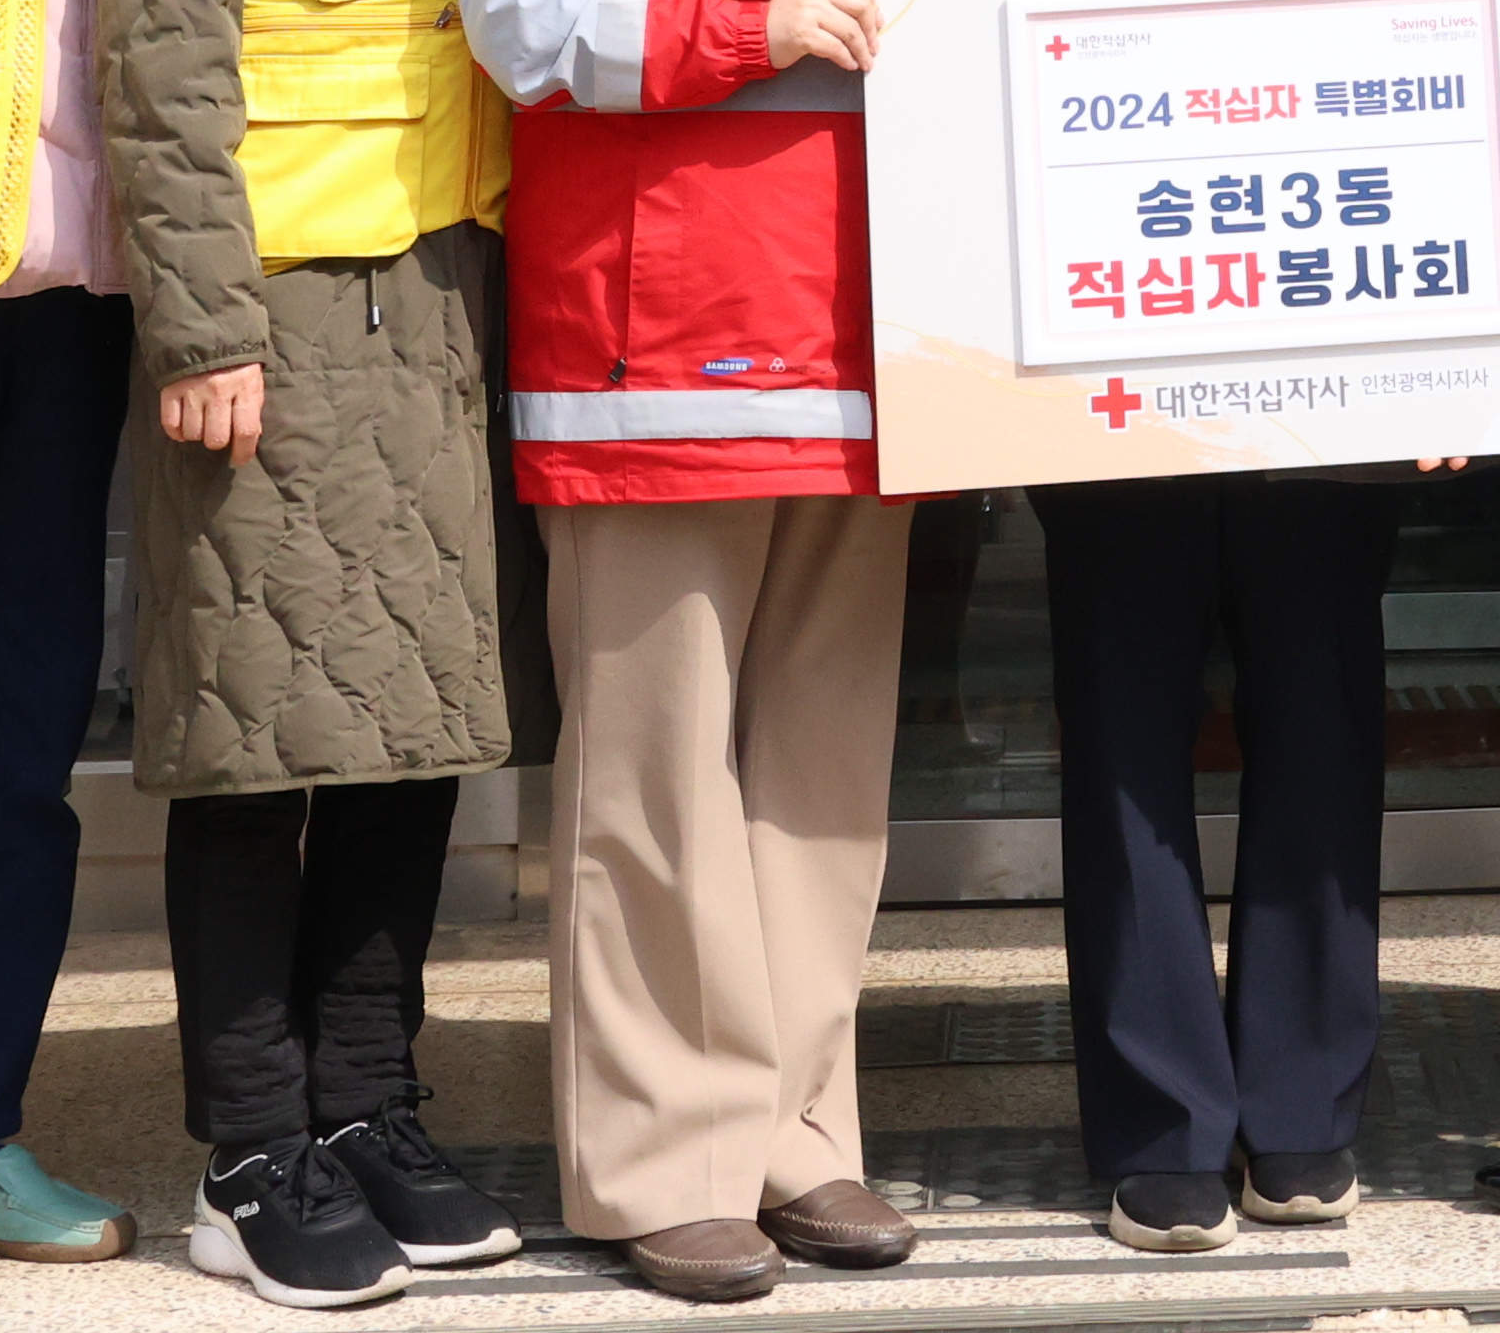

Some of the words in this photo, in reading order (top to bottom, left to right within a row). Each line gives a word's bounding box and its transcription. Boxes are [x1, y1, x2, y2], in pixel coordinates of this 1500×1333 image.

[1076, 33, 1152, 49] 대한적십자사
[1391, 17, 1437, 31] Saving
[1441, 15, 1478, 28] Lives,
[1061, 91, 1174, 133] 2024
[1185, 84, 1300, 124] 적십자
[1314, 74, 1466, 117] 특별회비
[1137, 166, 1392, 238] 송현3동
[1067, 239, 1470, 319] 적십자봉사회
[706, 362, 747, 371] SAMSUNG
[1156, 376, 1350, 419] 대한적십자사
[1361, 367, 1490, 395] 인천광역시지사
[233, 1201, 260, 1221] FILA
